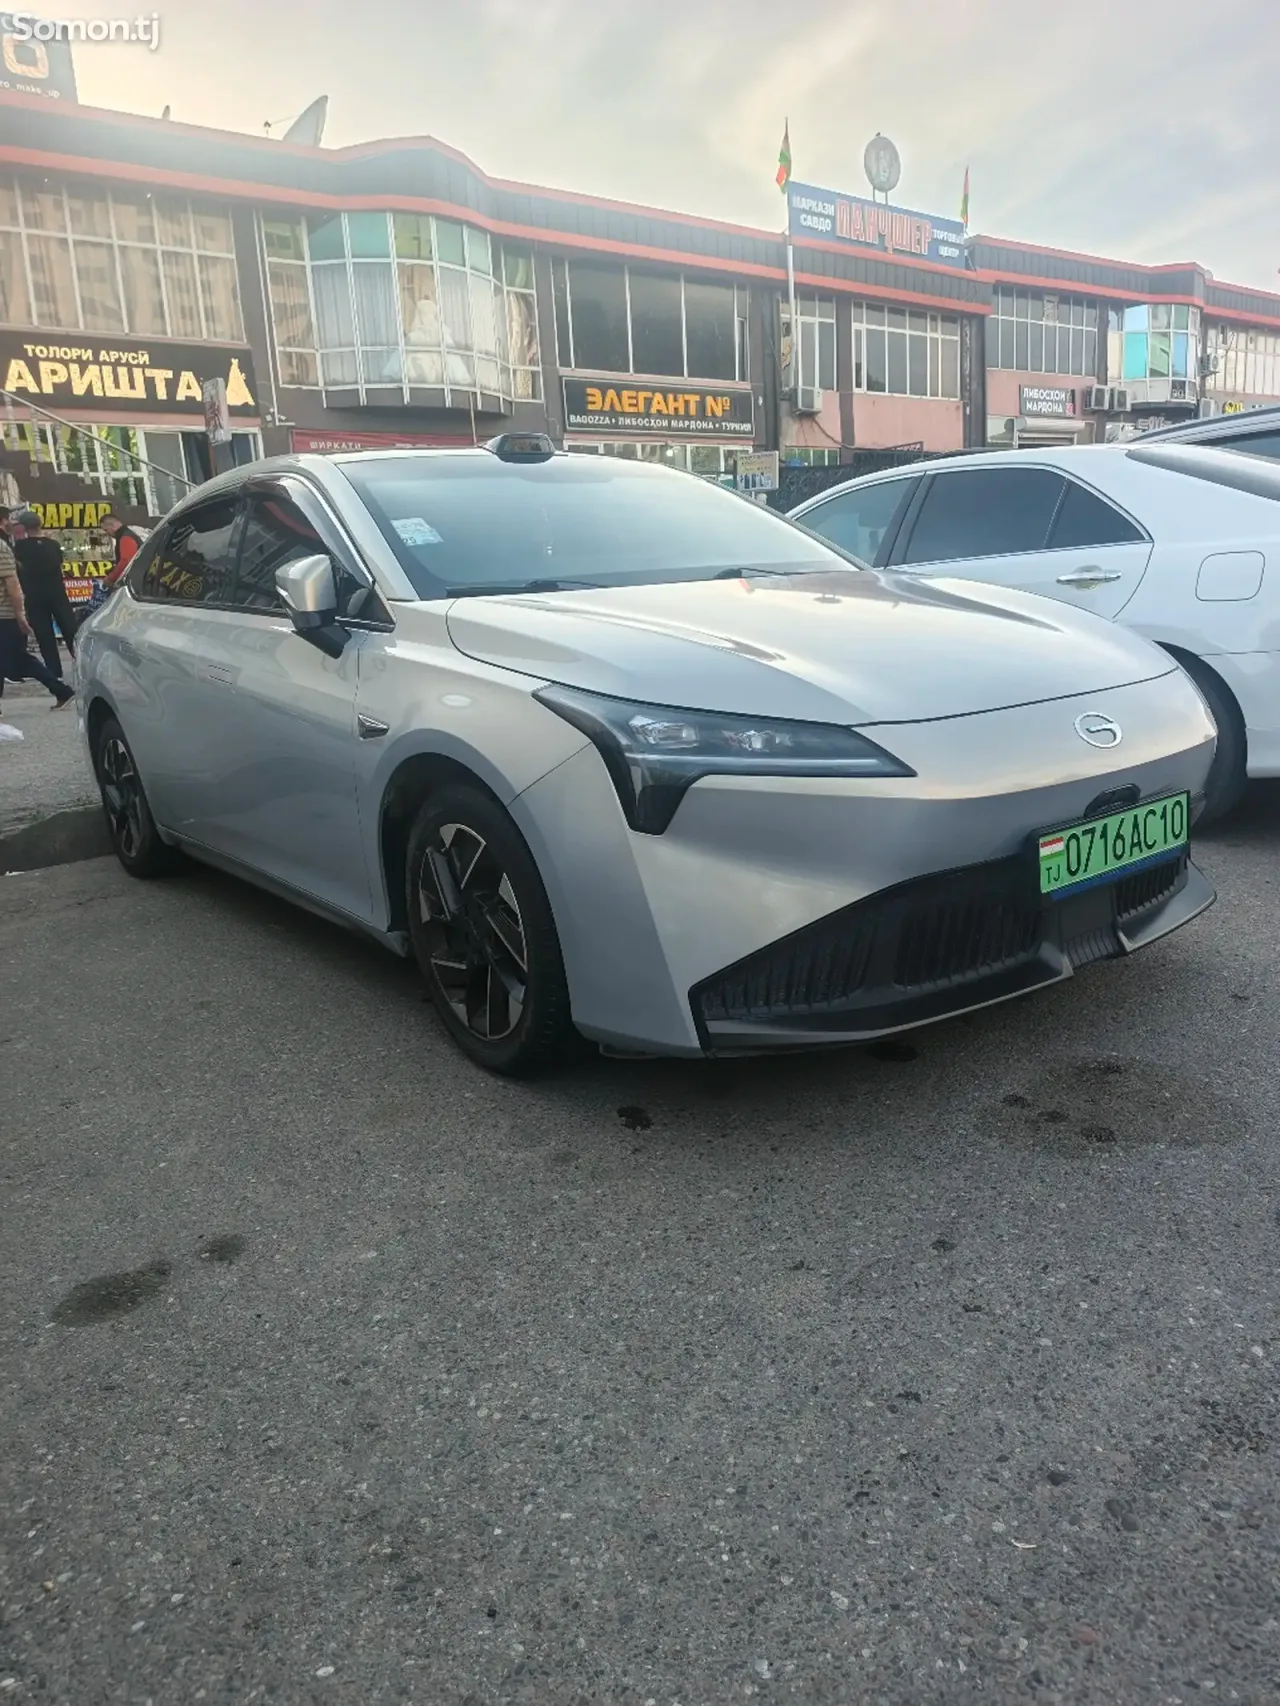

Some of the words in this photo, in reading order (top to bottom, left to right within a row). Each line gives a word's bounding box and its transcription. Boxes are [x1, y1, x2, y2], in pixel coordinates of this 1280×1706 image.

[791, 194, 835, 216] МАРКАЗИ
[800, 214, 832, 232] САВДО
[23, 344, 93, 361] ТОЛОРИ
[4, 358, 203, 402] АРИШТА
[586, 387, 701, 416] ЭЛЕГАНТ
[1026, 400, 1063, 414] МАРДОНА
[569, 414, 611, 424] BAGOZZA
[671, 419, 714, 430] МАРДОНА
[721, 421, 752, 432] ТУРКИЯ
[1065, 799, 1184, 877] 0716AC10
[1046, 863, 1061, 884] TJ
